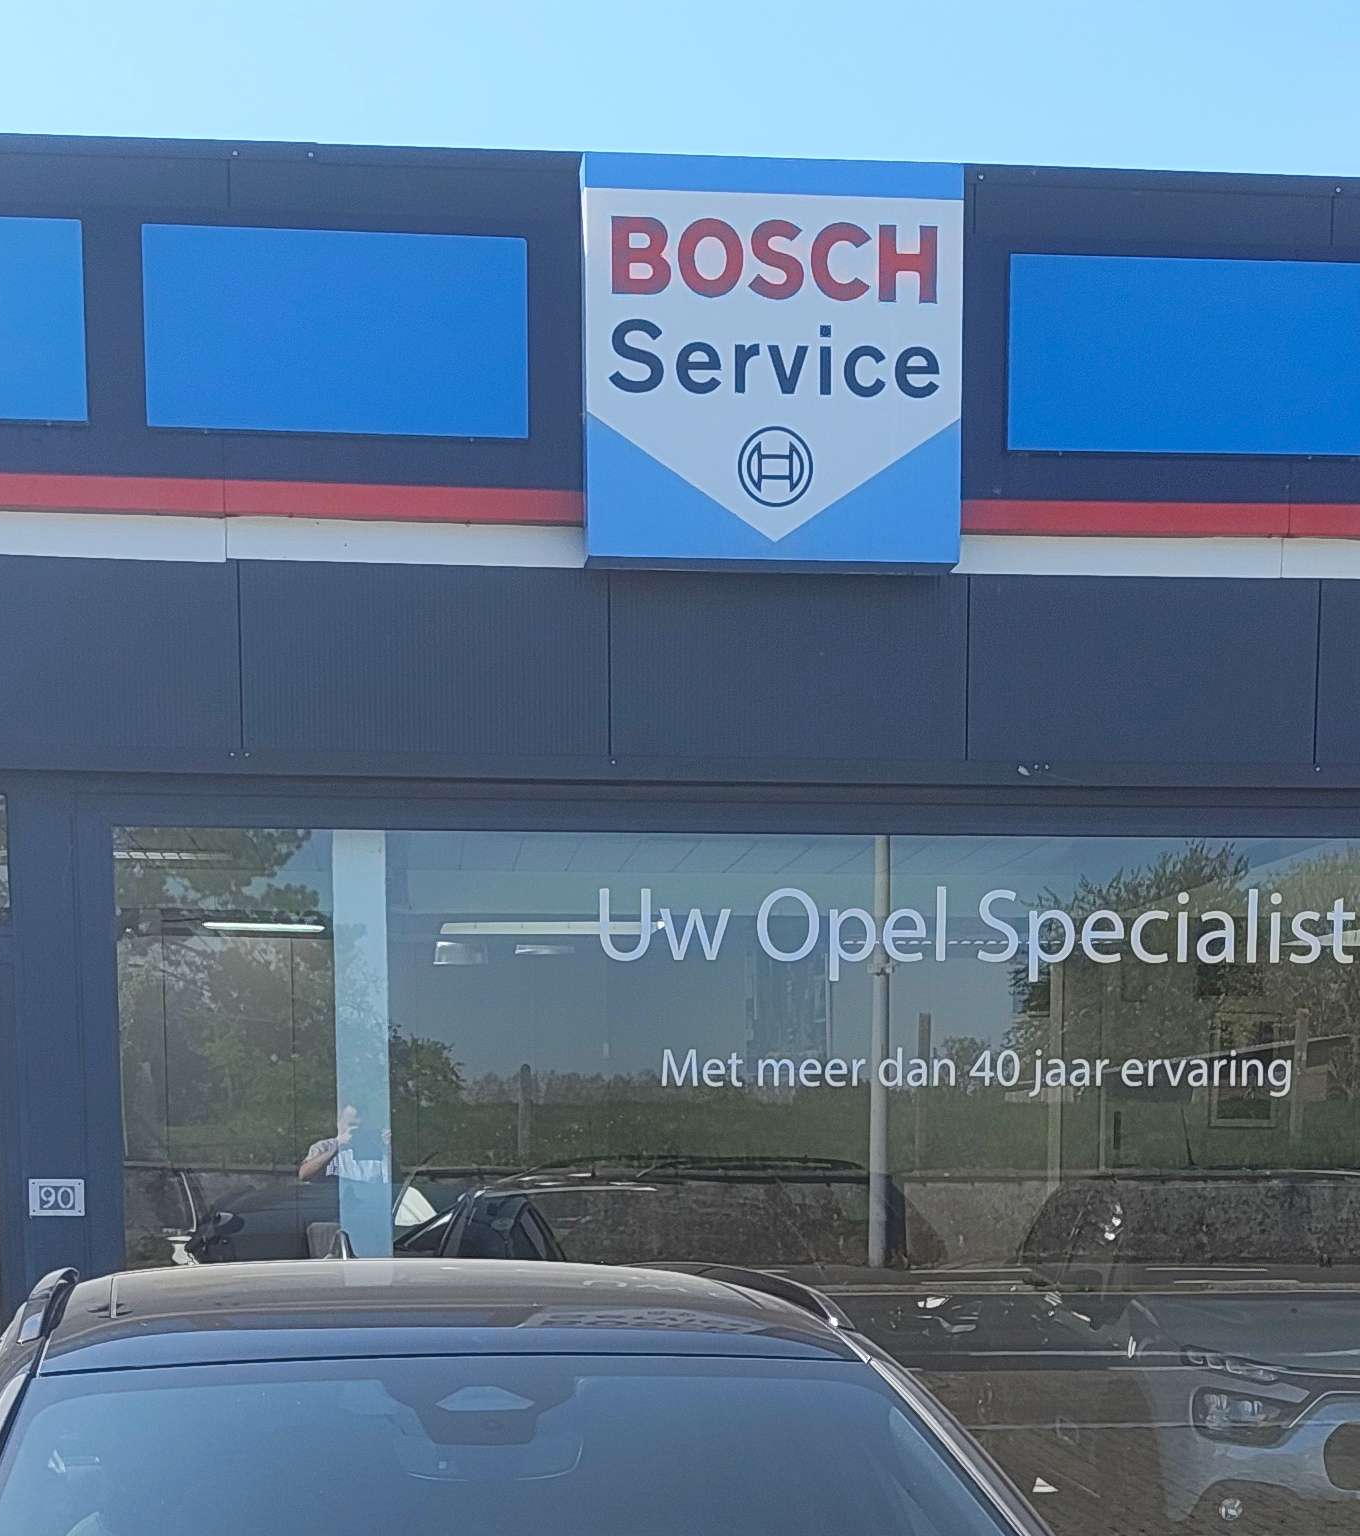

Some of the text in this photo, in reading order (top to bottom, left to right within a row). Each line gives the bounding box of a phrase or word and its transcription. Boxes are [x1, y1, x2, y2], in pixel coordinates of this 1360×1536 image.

[611, 215, 938, 304] BOSCH
[608, 318, 941, 399] Service
[597, 885, 1356, 983] Uw Opel Specialist
[661, 1047, 1293, 1097] Met meer dan 40 jaar ervaring
[40, 1185, 74, 1209] 90
